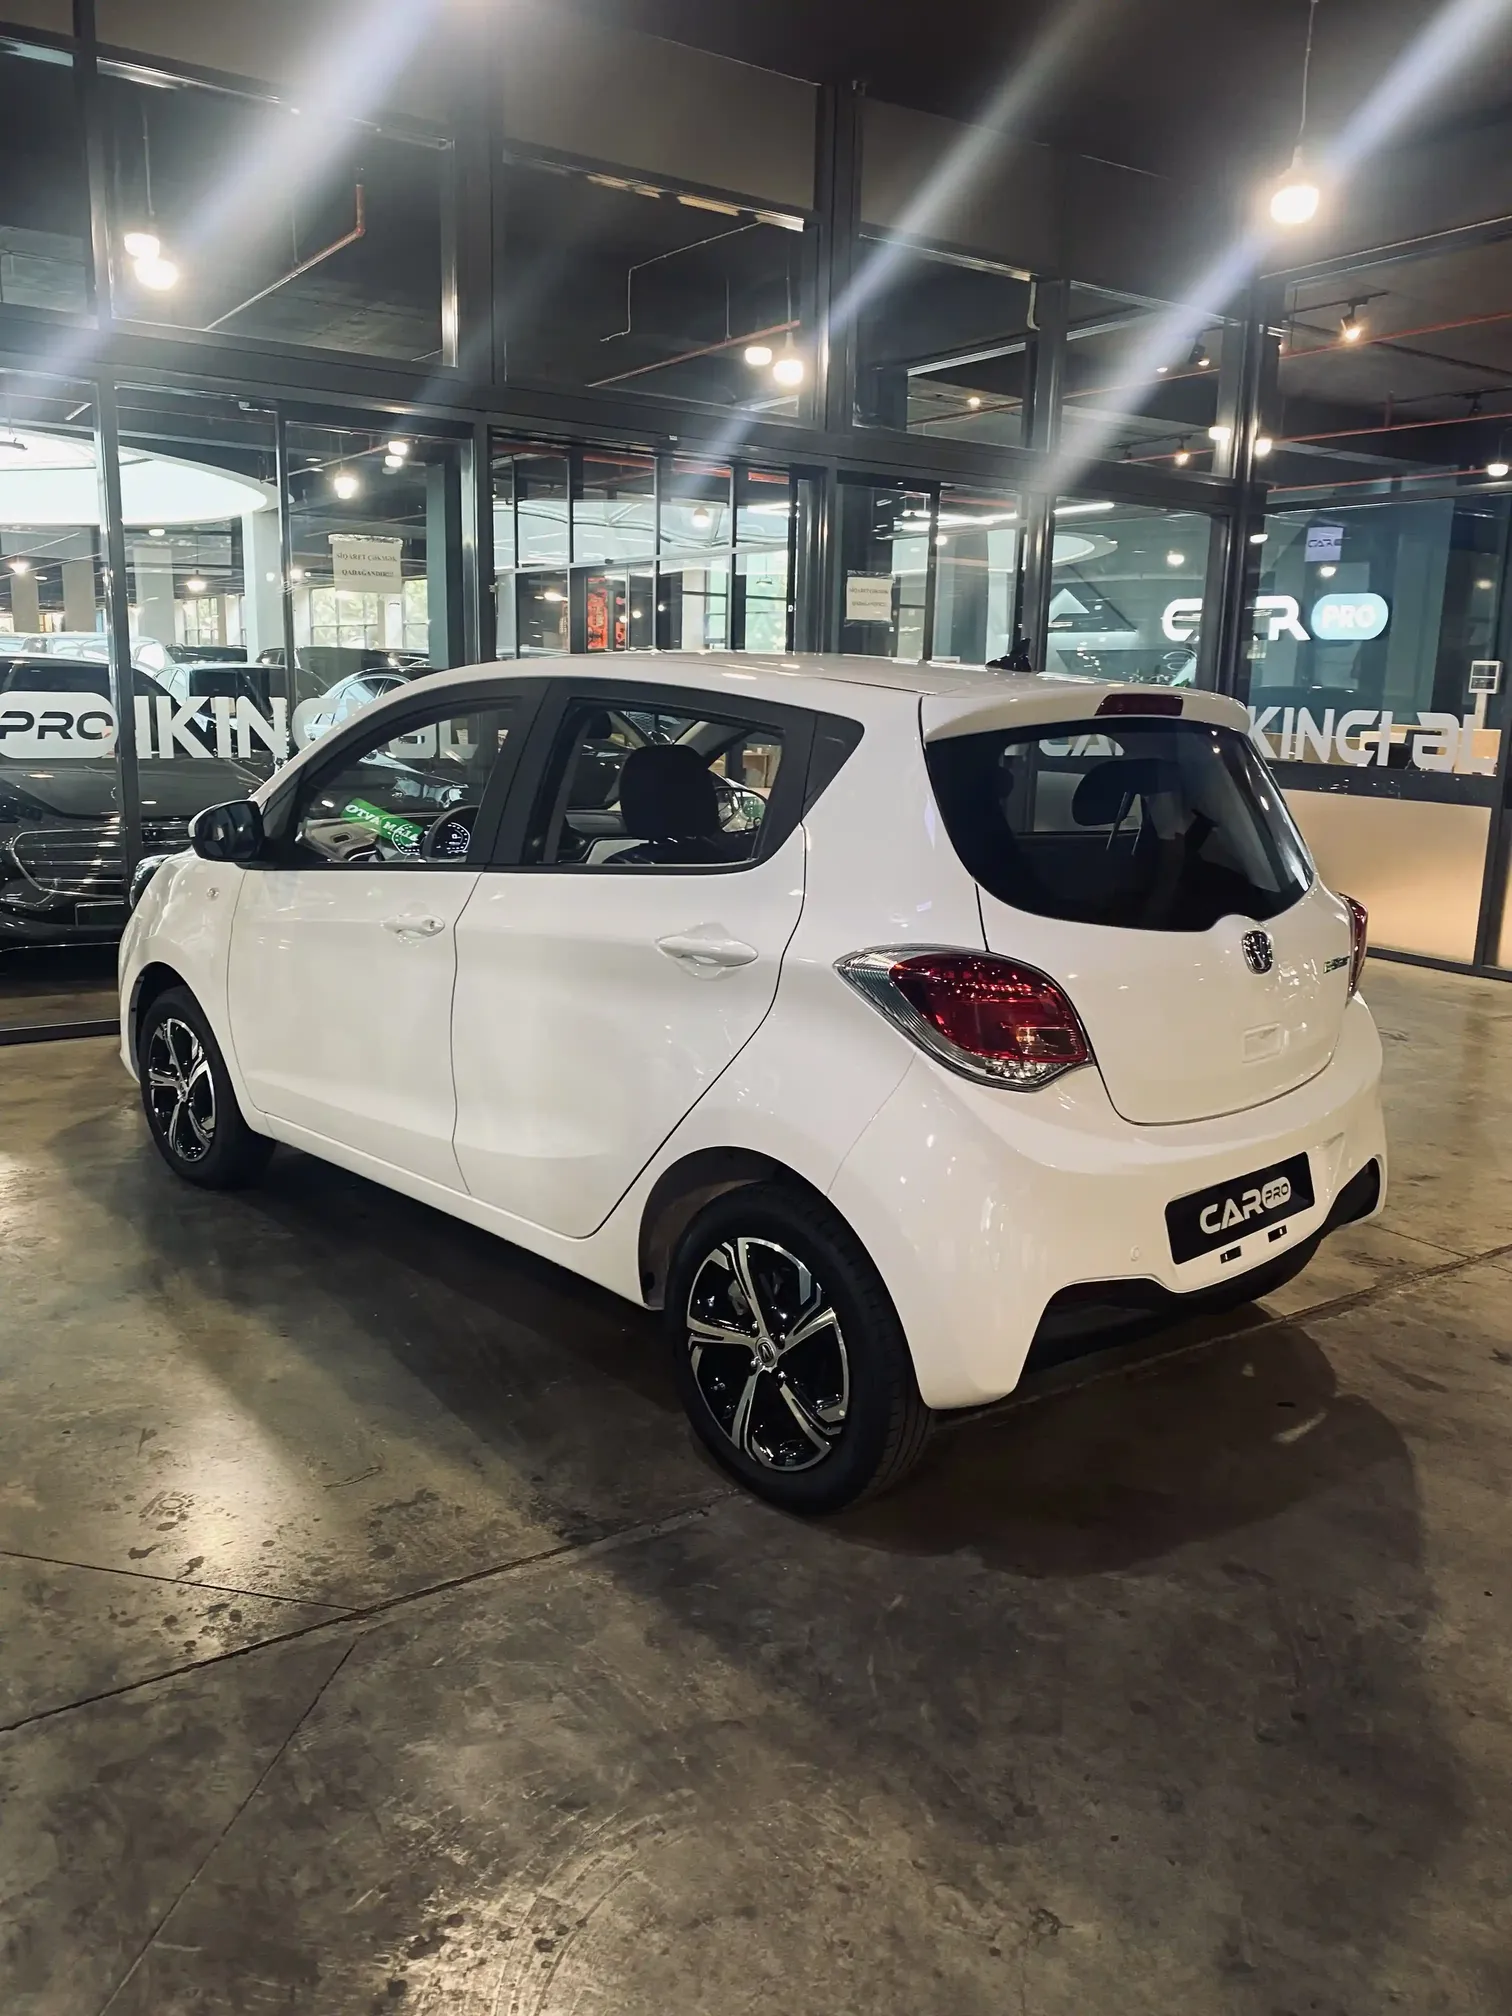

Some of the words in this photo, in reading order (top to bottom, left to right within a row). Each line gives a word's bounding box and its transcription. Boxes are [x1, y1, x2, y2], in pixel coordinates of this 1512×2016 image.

[1162, 595, 1311, 641] CR
[1321, 605, 1376, 629] PRO
[0, 711, 114, 740] PRO
[1200, 1188, 1264, 1234] CAR
[1265, 1182, 1289, 1204] PRO
